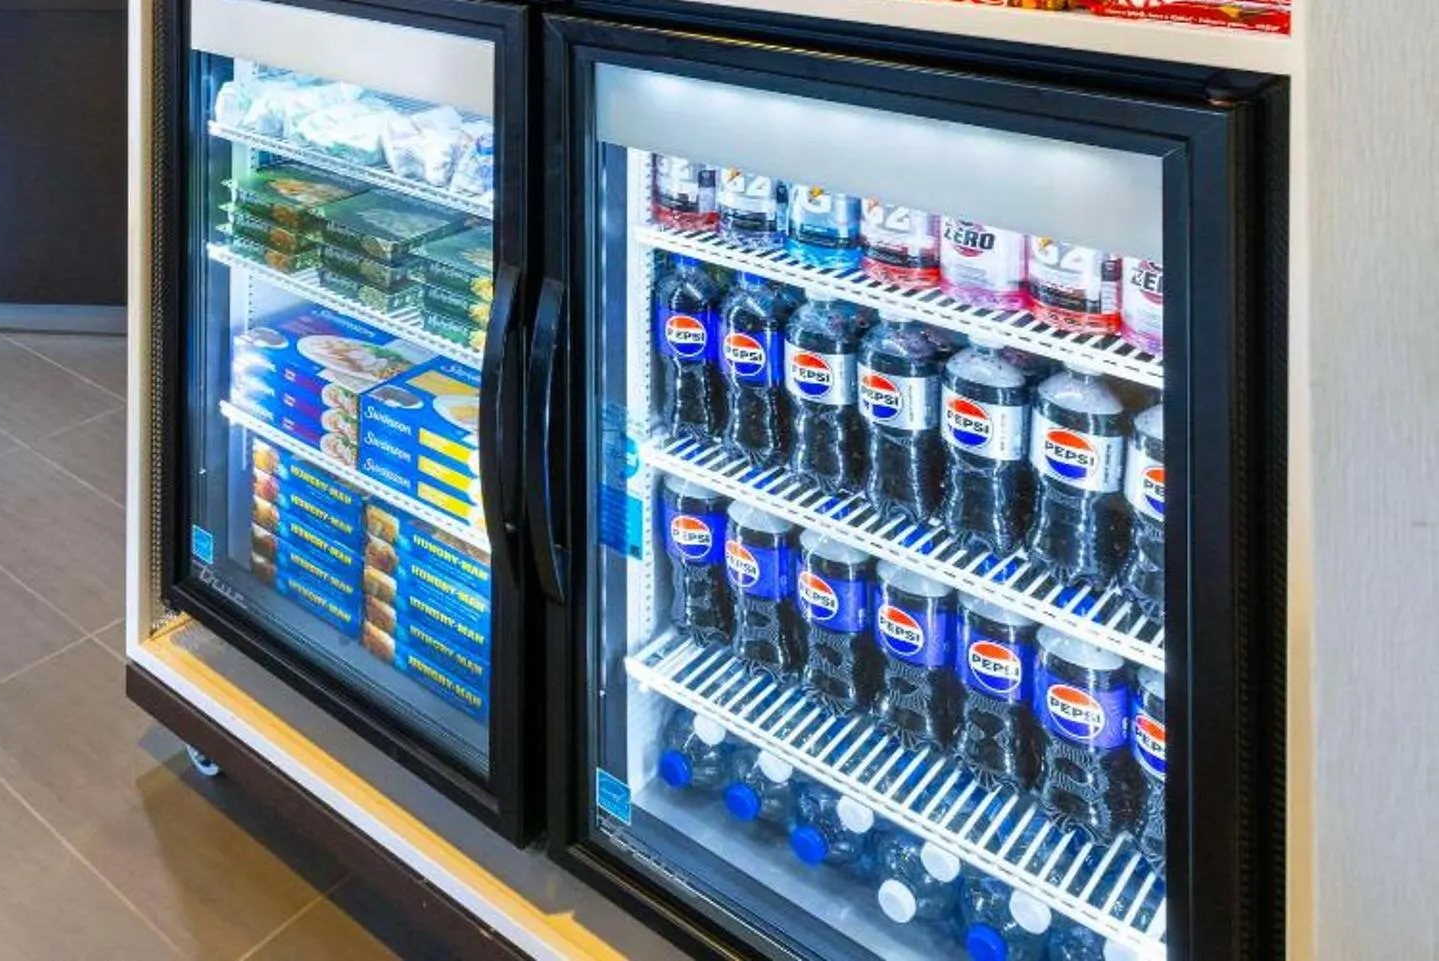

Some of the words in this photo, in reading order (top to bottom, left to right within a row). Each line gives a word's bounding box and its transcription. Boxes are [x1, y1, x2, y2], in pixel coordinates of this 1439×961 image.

[944, 228, 996, 250] ZERO
[1131, 267, 1163, 293] ZE
[667, 328, 705, 342] PEPSI
[727, 345, 762, 363] PEPSI
[792, 364, 830, 384] PEPSI
[862, 384, 899, 407] PEPSI
[363, 405, 411, 435] Swanson
[946, 408, 989, 436] PEPSI
[1044, 440, 1095, 467] PEPSI
[413, 534, 488, 581] HUNGRY-MAN
[411, 565, 486, 613] HUNGRY-MAN
[880, 614, 921, 644] PEPSI
[971, 653, 1020, 678] PEPSI
[1049, 696, 1101, 725] PEPSI
